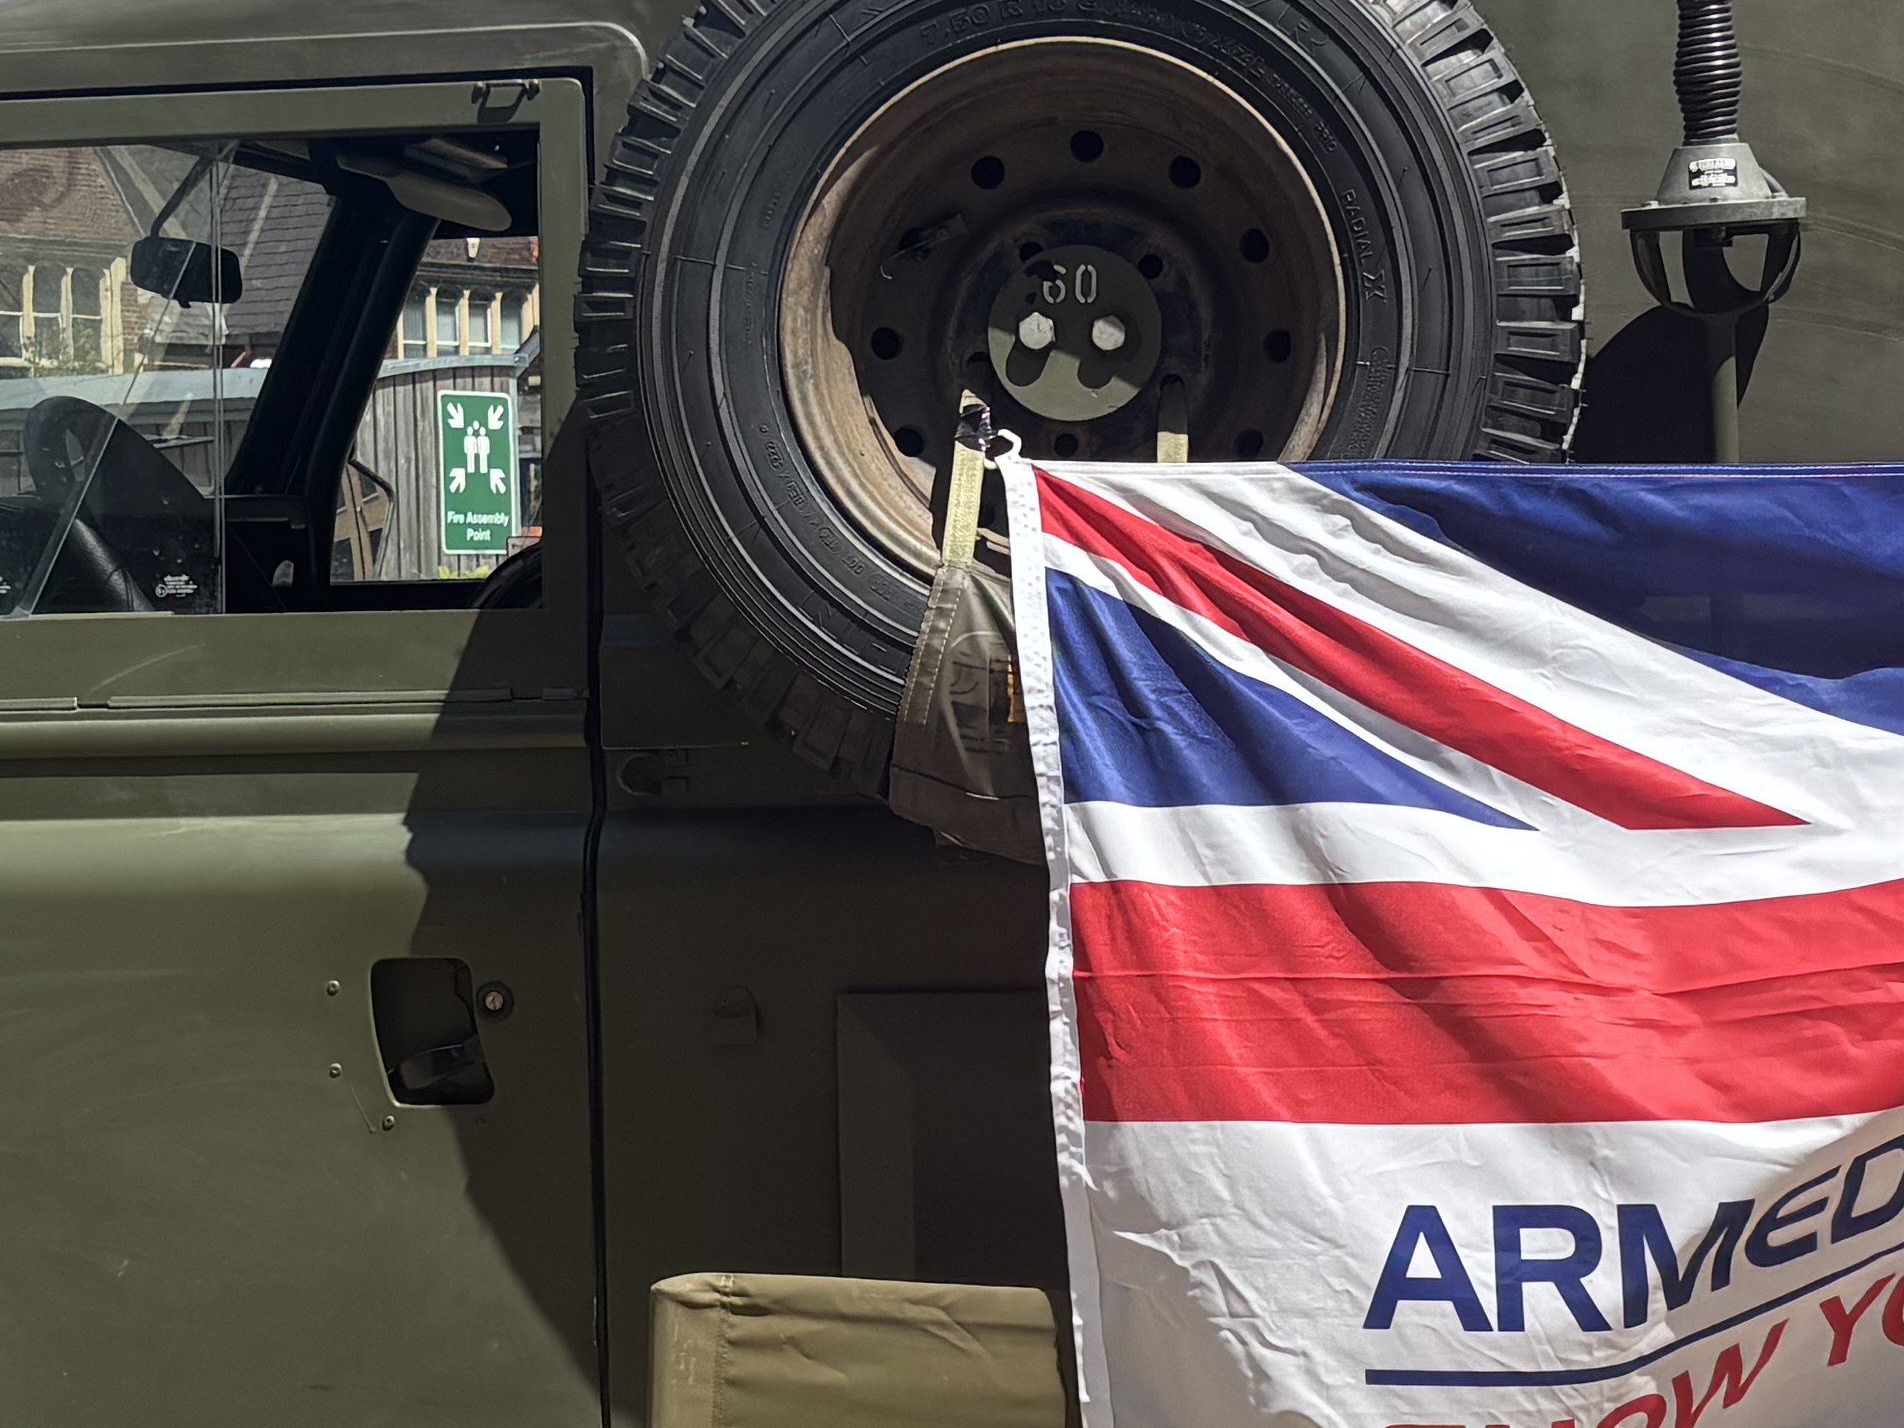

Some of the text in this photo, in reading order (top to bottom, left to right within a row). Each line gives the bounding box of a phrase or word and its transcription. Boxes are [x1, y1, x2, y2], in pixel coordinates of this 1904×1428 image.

[1340, 187, 1387, 300] RADIAL X
[447, 510, 509, 527] Fire Assembly
[466, 528, 491, 541] Point
